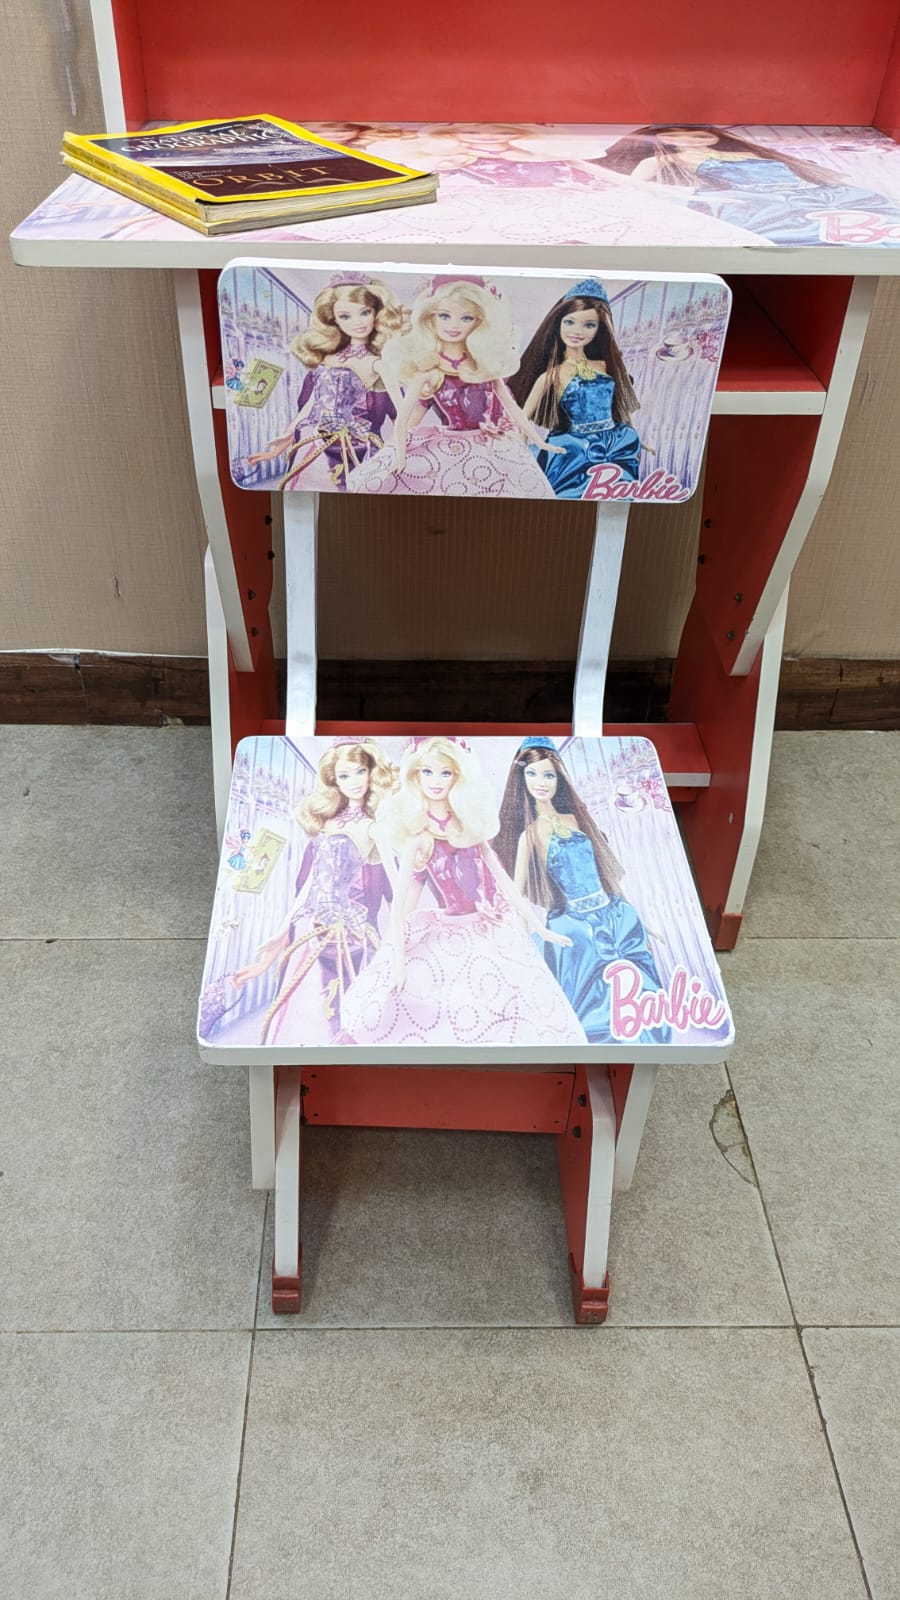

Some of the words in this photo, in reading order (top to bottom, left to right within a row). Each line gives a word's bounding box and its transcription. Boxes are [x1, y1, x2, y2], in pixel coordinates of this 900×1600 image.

[121, 129, 281, 152] GEOGRAPHIC
[193, 166, 330, 186] ORBIT
[583, 463, 689, 500] Barbie
[605, 961, 726, 1039] Barbie
